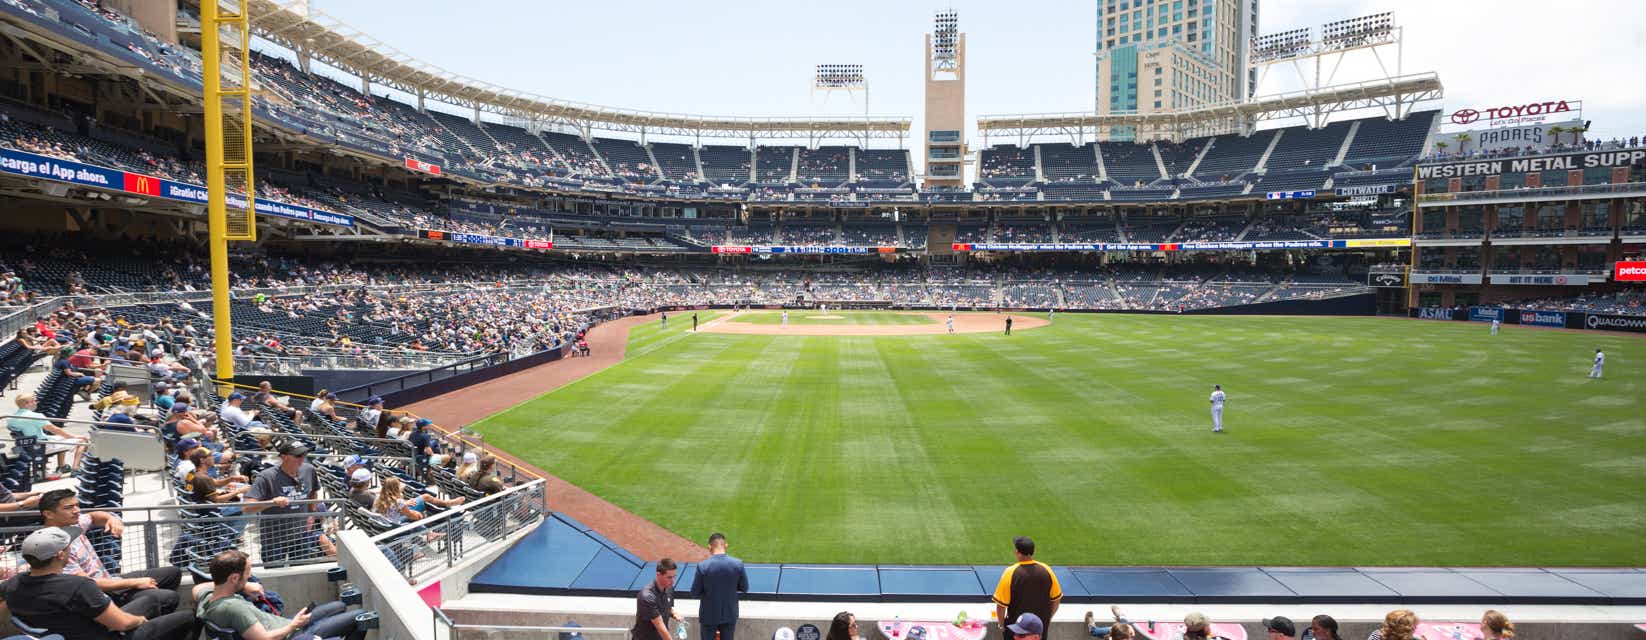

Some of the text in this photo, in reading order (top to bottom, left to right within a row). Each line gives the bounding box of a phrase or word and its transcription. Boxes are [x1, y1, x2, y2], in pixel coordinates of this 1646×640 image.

[1486, 100, 1570, 119] TOYOTA
[1479, 126, 1542, 147] PADRES
[39, 161, 51, 175] el
[52, 164, 76, 180] App
[1418, 151, 1646, 179] WESTERN METAL SUPP
[1342, 185, 1388, 196] CUTWATER
[1619, 266, 1646, 277] petco
[1419, 307, 1452, 320] ASML
